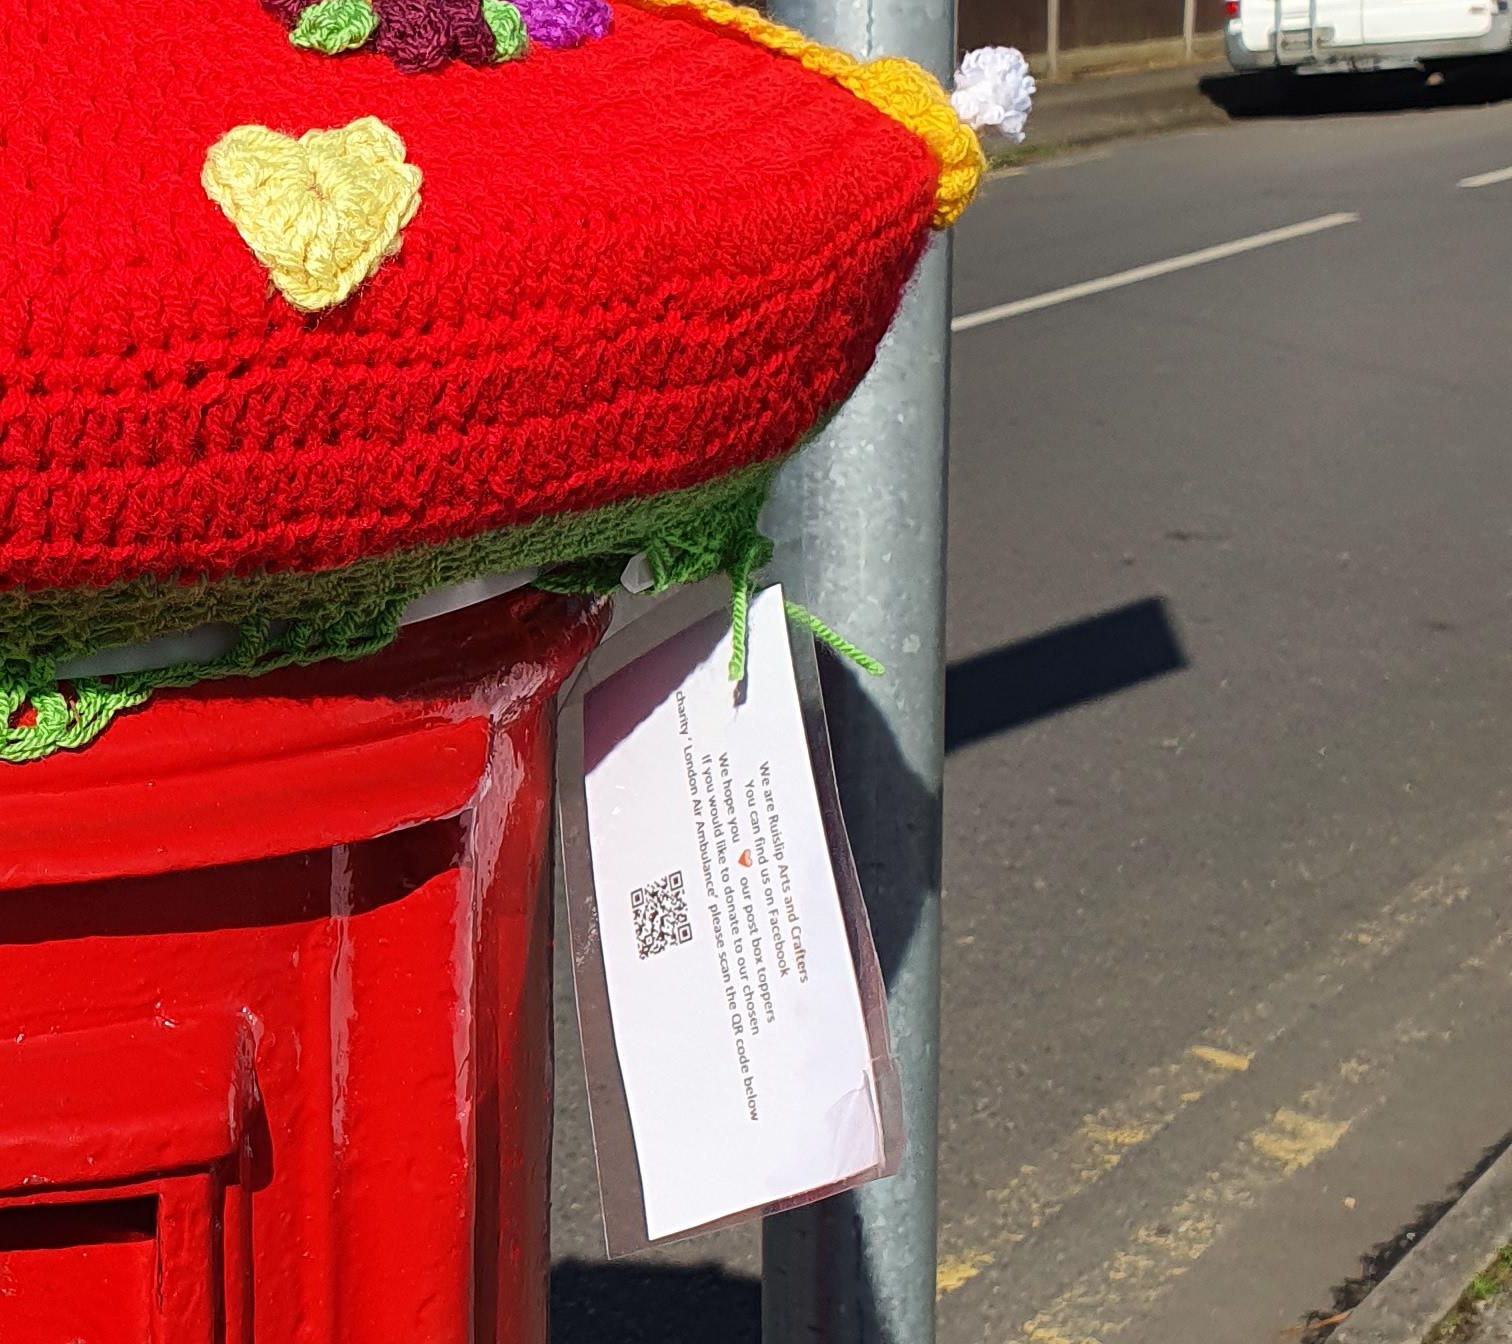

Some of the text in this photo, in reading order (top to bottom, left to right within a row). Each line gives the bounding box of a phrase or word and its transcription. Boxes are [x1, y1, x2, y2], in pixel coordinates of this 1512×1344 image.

[676, 690, 689, 736] charity
[684, 745, 699, 796] London
[692, 799, 702, 817] Air
[701, 754, 759, 1036] If you would like to donate to our chosen
[718, 752, 775, 1024] We hope you our post box toppers
[744, 779, 791, 977] You can find us on Facebook
[759, 761, 809, 984] We are Ruislip Arts and Crafters
[708, 903, 725, 948] please
[719, 951, 731, 983] scan
[725, 986, 737, 1010] the
[731, 1013, 743, 1036] QR
[736, 1039, 750, 1074] code
[744, 1076, 758, 1121] below
